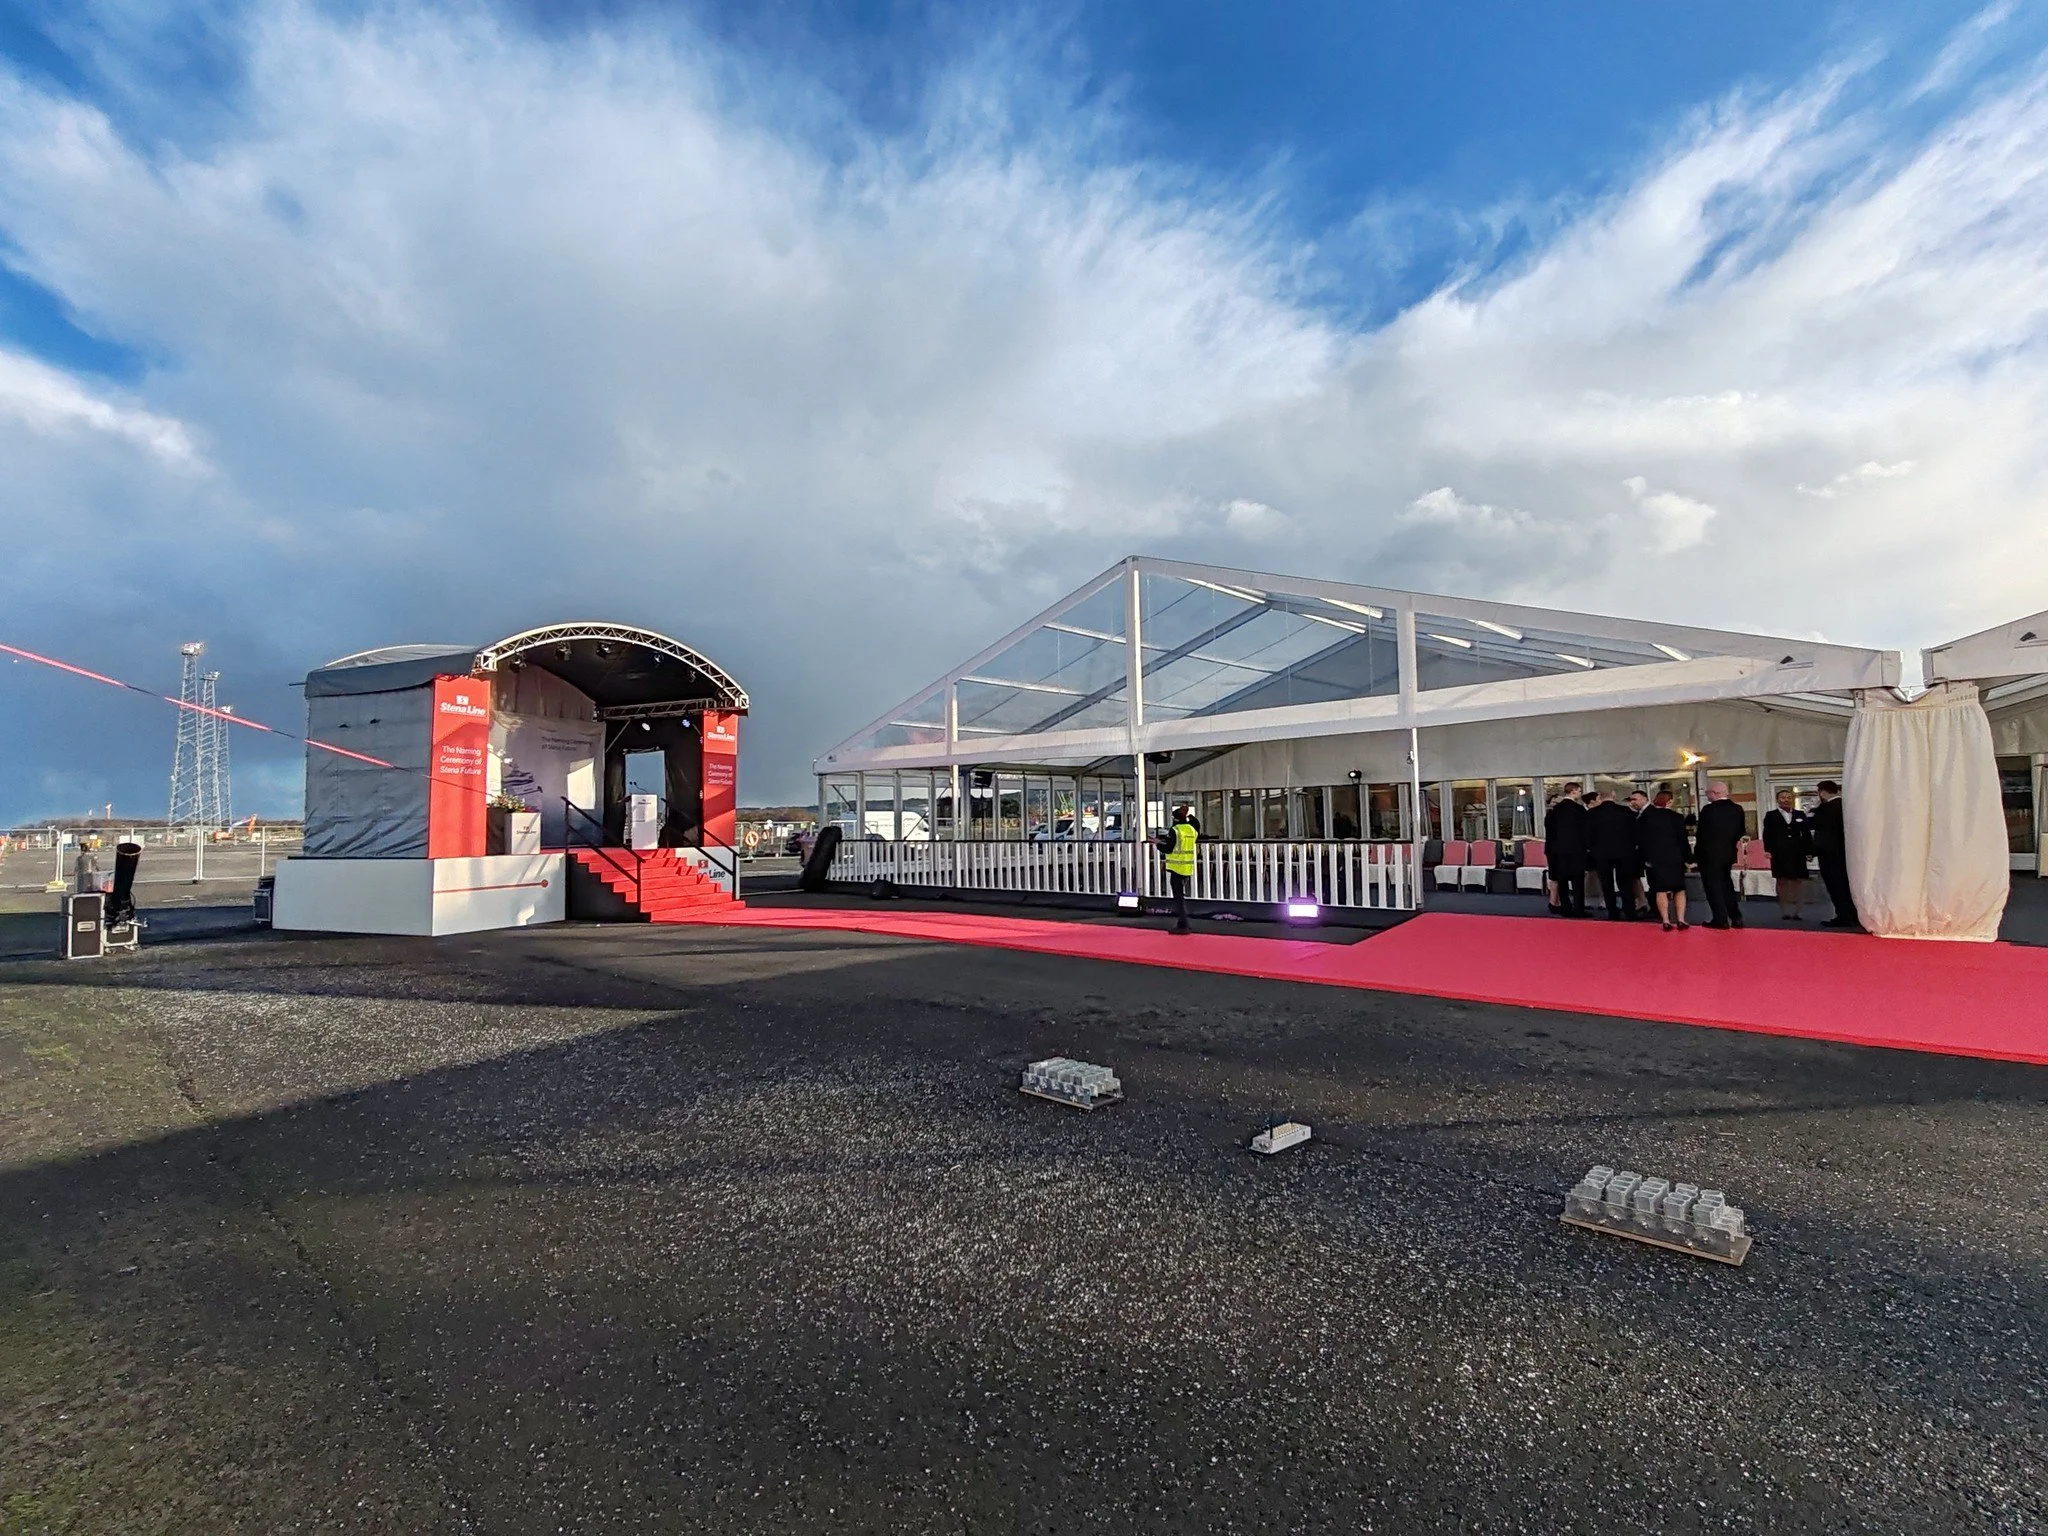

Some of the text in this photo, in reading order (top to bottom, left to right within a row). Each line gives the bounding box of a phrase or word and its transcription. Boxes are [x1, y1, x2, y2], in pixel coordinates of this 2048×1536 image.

[440, 702, 486, 716] Stena Line
[442, 745, 481, 757] The Naming
[440, 755, 473, 765] Ceremony
[440, 766, 481, 775] Stena Future
[709, 869, 725, 878] Line
